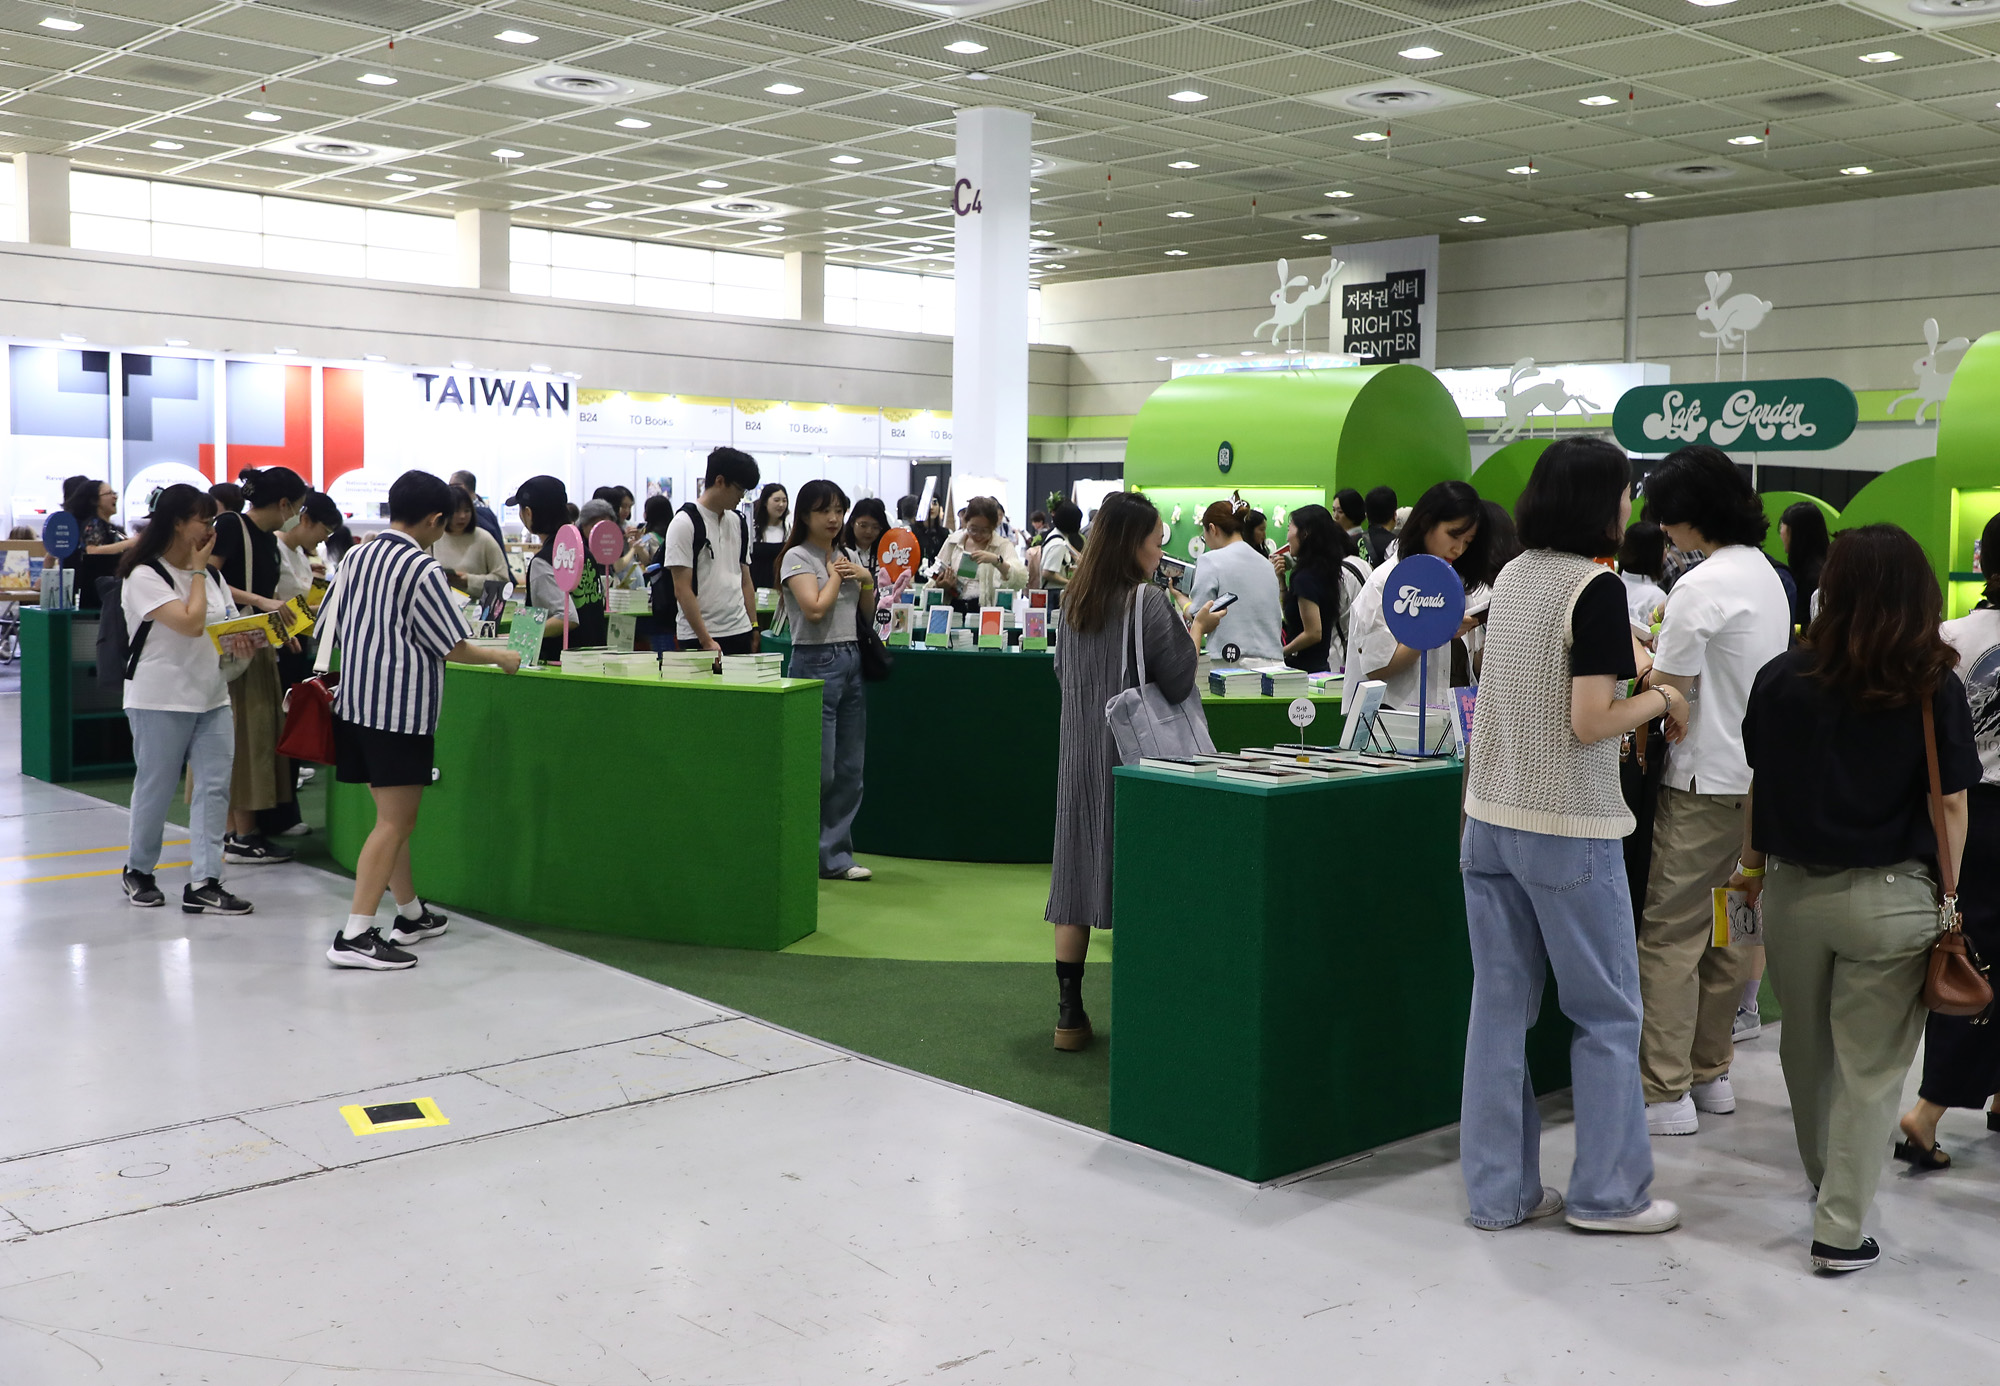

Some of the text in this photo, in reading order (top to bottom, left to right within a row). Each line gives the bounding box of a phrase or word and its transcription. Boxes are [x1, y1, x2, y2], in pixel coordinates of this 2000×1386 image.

[954, 178, 982, 216] C4
[1346, 278, 1418, 311] 저작권 센터
[1351, 309, 1412, 335] RIGHTS
[1348, 333, 1416, 357] CENTER
[415, 372, 569, 413] TAIWAN
[579, 412, 598, 422] B24
[629, 414, 674, 427] TO Books
[745, 421, 762, 431] B24
[789, 423, 828, 434] TO Books
[1643, 389, 1817, 446] Safe Garden
[891, 428, 906, 438] B24
[942, 431, 953, 440] Bo
[1393, 585, 1446, 617] Awards
